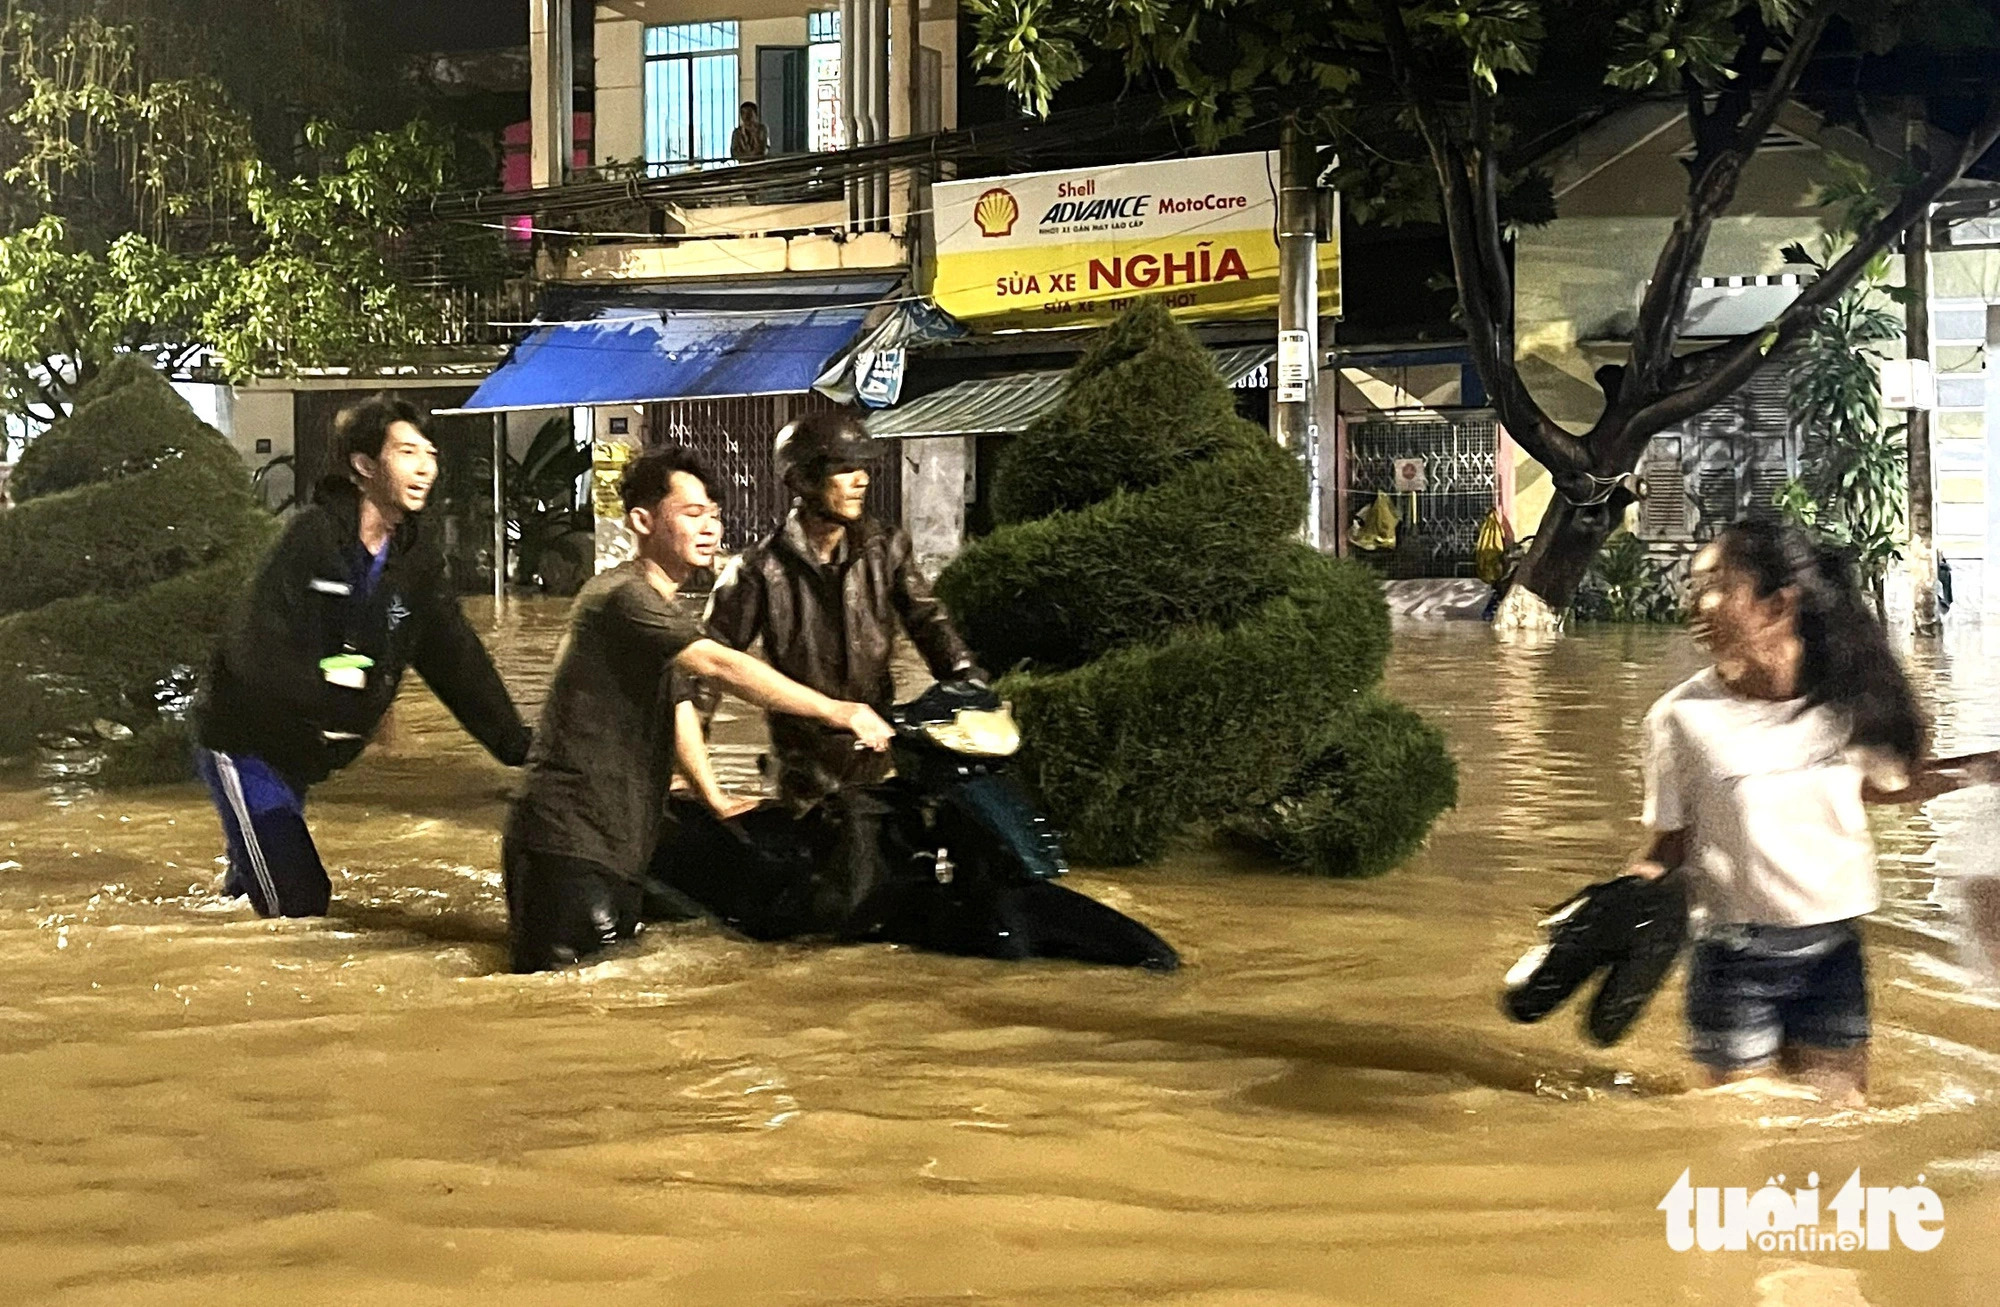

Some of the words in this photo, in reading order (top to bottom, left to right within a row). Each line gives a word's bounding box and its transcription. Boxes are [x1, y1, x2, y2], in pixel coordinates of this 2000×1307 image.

[1057, 180, 1095, 197] Shell
[1039, 195, 1152, 224] ADVANCE
[1158, 194, 1247, 214] MotoCare
[1048, 273, 1076, 293] XE
[1088, 241, 1250, 290] NGHĨA
